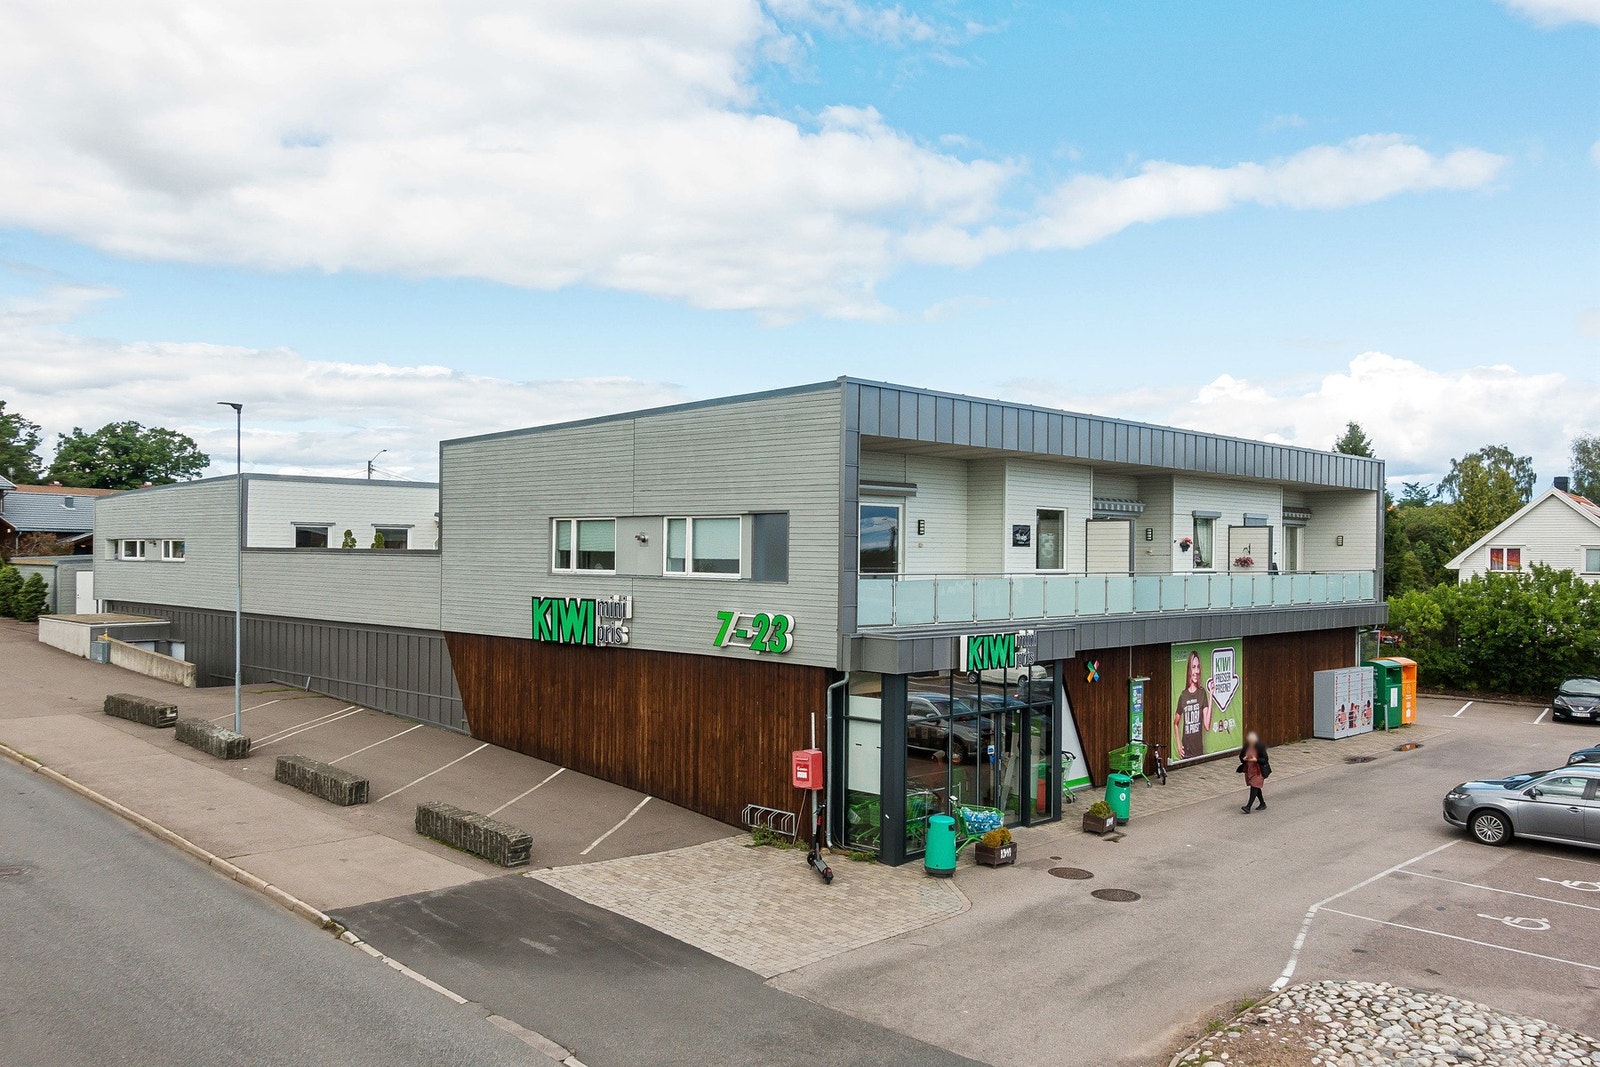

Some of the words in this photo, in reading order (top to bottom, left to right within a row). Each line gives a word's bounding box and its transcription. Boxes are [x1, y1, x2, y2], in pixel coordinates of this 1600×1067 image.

[531, 596, 597, 645] KIWI
[597, 597, 630, 618] mini
[597, 621, 628, 647] pris
[713, 610, 791, 654] 7-23
[967, 633, 1015, 672] KIWI
[1215, 656, 1231, 673] KIWI
